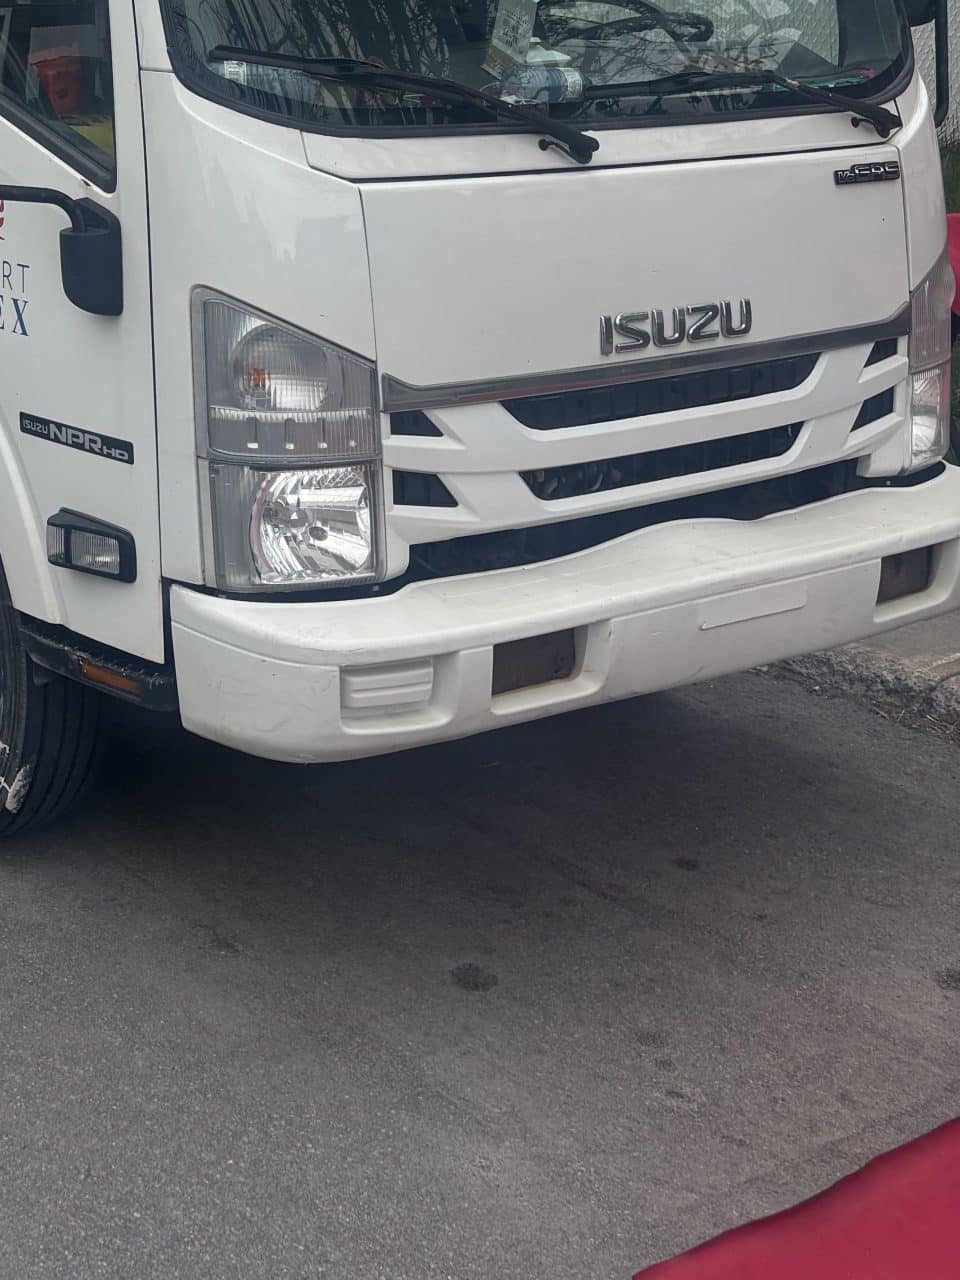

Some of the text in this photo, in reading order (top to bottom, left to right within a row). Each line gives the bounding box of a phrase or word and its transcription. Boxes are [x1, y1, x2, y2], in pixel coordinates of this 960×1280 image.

[600, 296, 753, 356] ISUZU
[22, 419, 129, 461] ISUZU NPR HD
